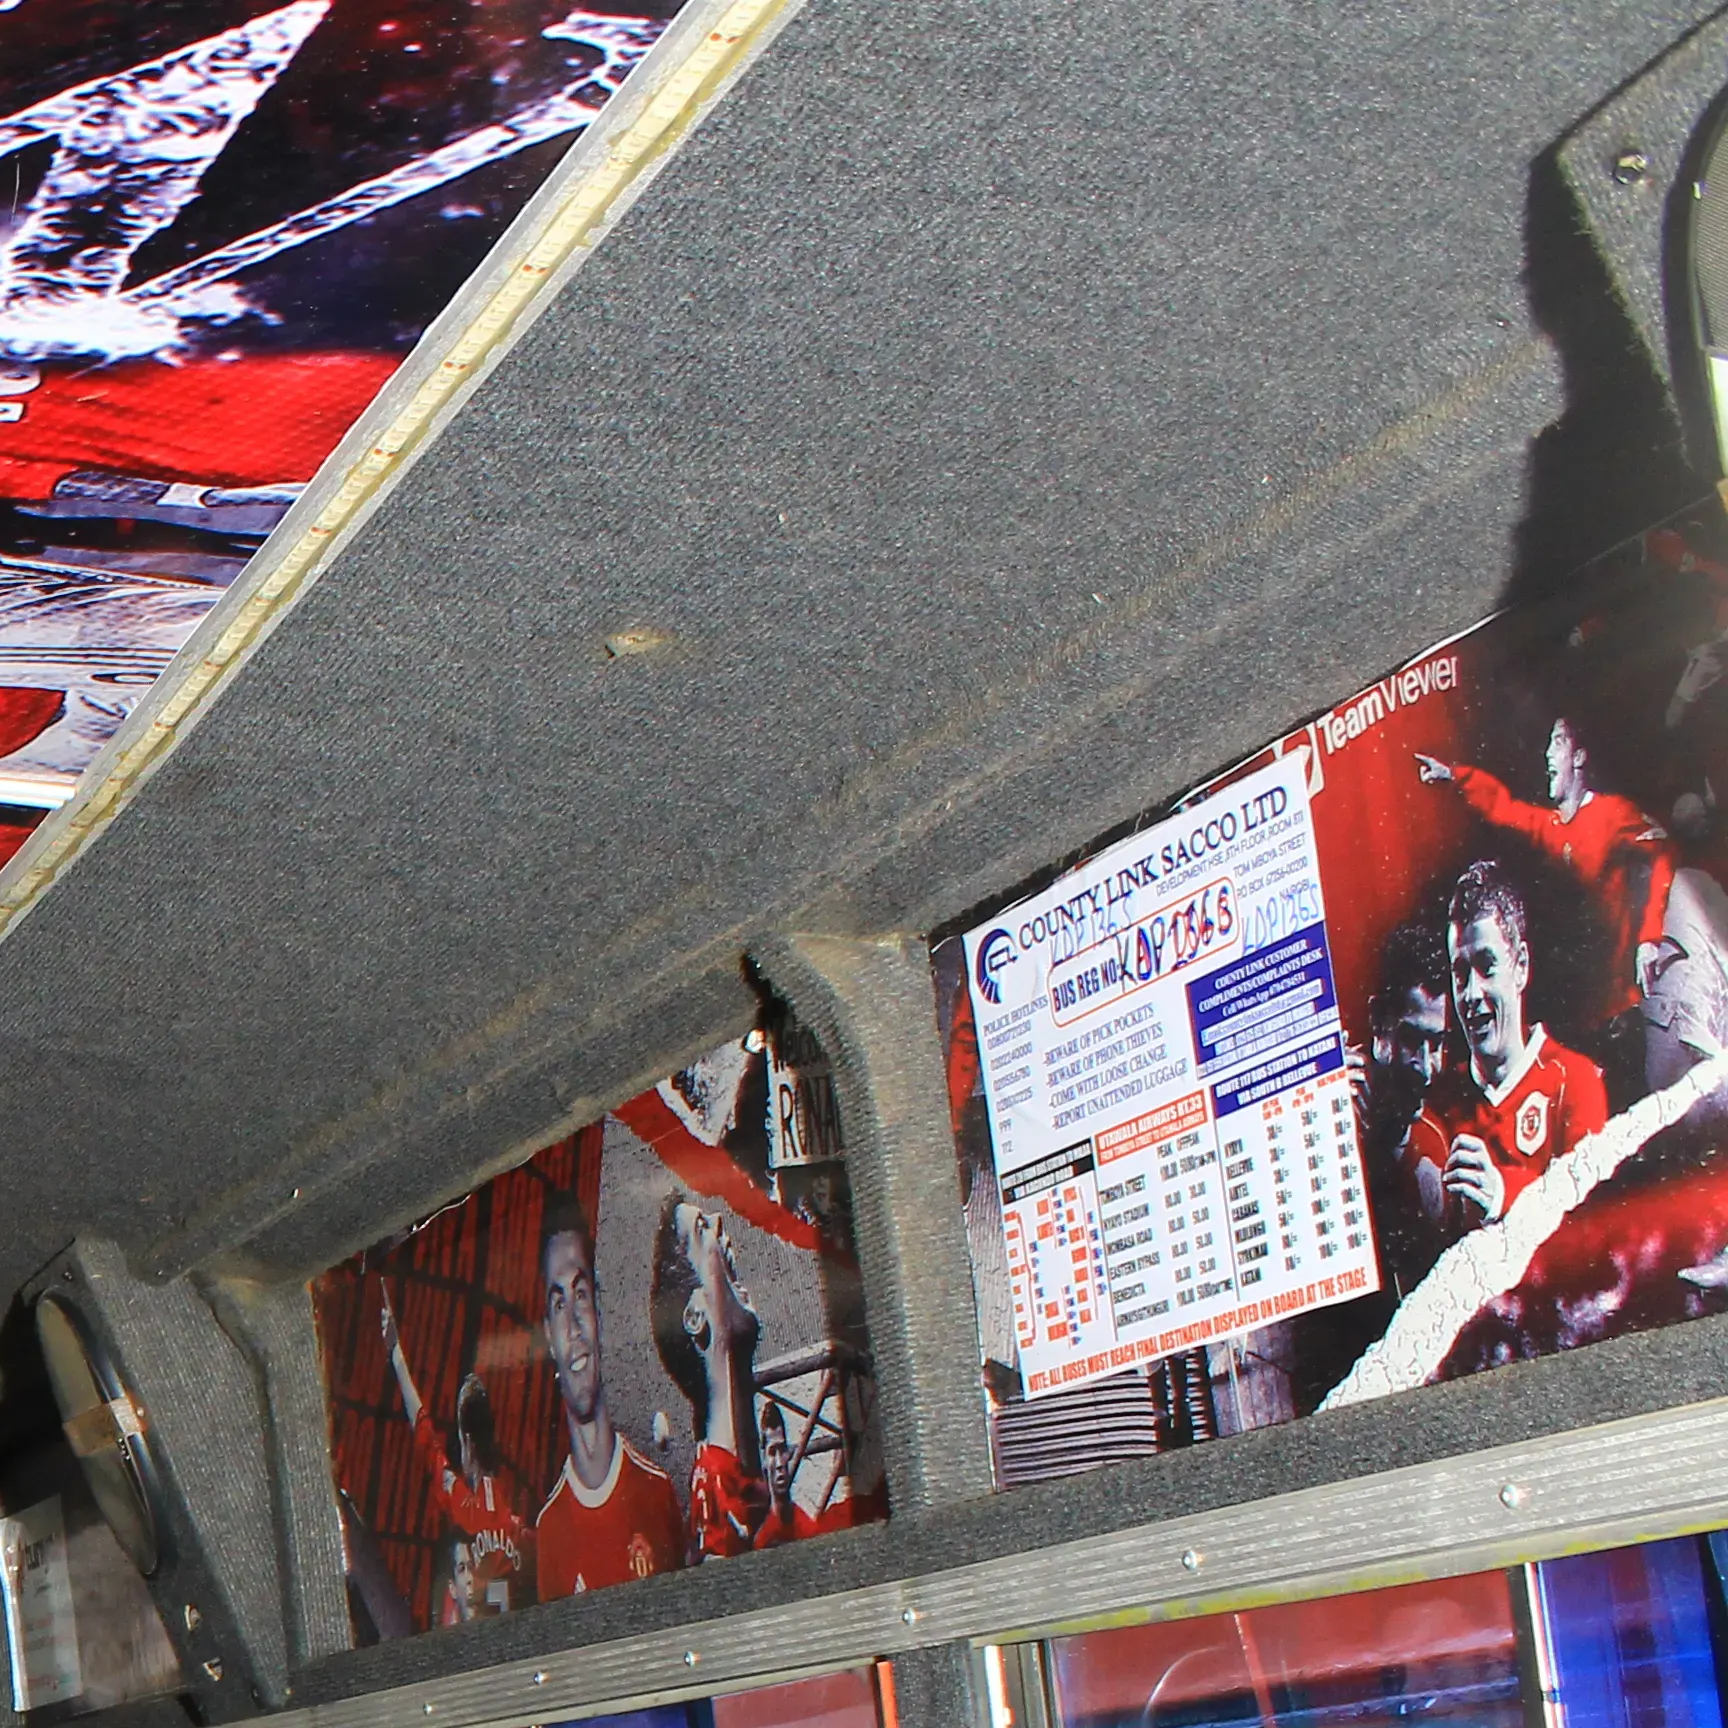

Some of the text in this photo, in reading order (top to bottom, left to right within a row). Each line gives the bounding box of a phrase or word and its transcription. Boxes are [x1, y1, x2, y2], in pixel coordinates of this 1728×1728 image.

[1017, 887, 1098, 954] COUNTY
[1104, 853, 1159, 904] LINK
[1160, 810, 1239, 875] SACCO
[1239, 782, 1288, 833] LTD
[1052, 977, 1076, 1013] BUS
[1076, 965, 1100, 1001] REG
[982, 1011, 1011, 1037] POLICE
[1080, 1030, 1093, 1051] OF
[1092, 1020, 1114, 1045] PICK
[1113, 1002, 1155, 1035] POCKETS
[1083, 1052, 1096, 1071] OF
[1095, 1039, 1125, 1066] PHONE
[1125, 1021, 1163, 1053] THIEVES
[1075, 1073, 1099, 1097] WITH
[1099, 1060, 1128, 1087] LOOSE
[1129, 1043, 1168, 1074] CHANGE
[1086, 1076, 1144, 1116] UNATTENDED
[1143, 1057, 1188, 1092] LUGGAGE
[1098, 1121, 1137, 1150] UTAWALA
[1137, 1105, 1176, 1134] AIRWAYS
[1047, 1365, 1062, 1387] ALL
[1061, 1357, 1087, 1382] BUSES
[1087, 1350, 1110, 1374] MUST
[1109, 1342, 1136, 1367] REACH
[1135, 1334, 1159, 1359] FINAL
[1158, 1317, 1213, 1352] DESTINATION
[1213, 1302, 1259, 1335] DISPLAYED
[1258, 1297, 1274, 1320] ON
[1273, 1287, 1305, 1316] BOARD
[1304, 1283, 1318, 1306] AT
[1317, 1277, 1336, 1302] THE
[1335, 1267, 1367, 1296] STAGE
[471, 1528, 521, 1572] RONALDO
